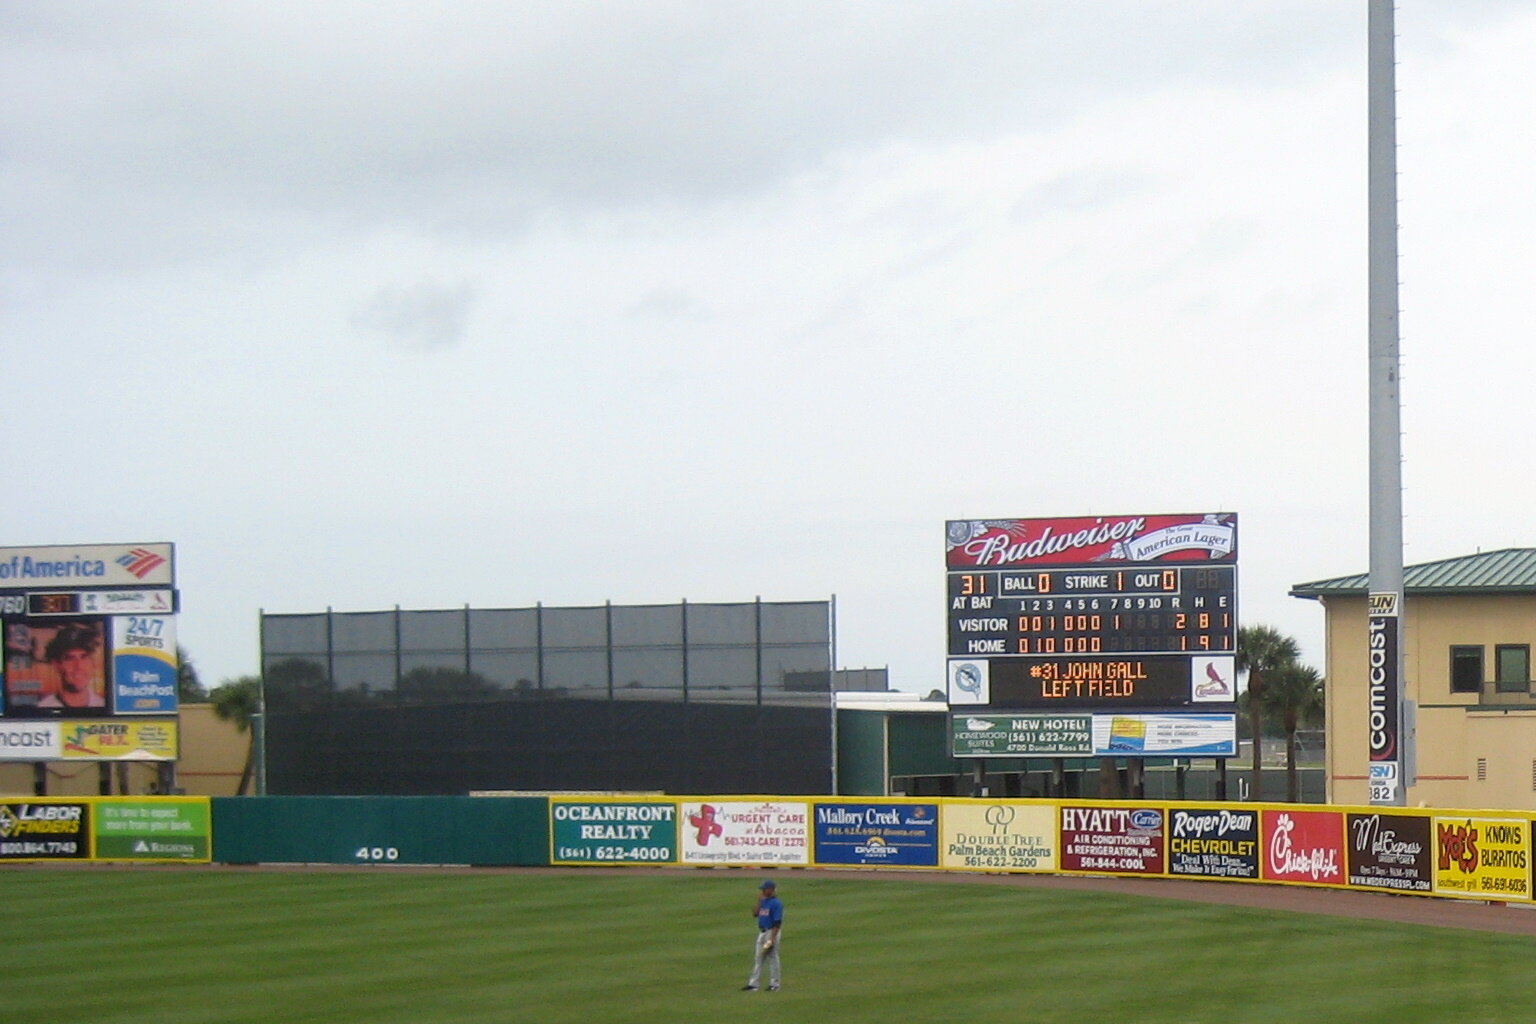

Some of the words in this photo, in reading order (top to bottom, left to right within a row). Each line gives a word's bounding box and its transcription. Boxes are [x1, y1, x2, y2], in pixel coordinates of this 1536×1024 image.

[965, 518, 1145, 565] Budweiser
[1136, 529, 1190, 558] American
[1194, 527, 1228, 547] Lager
[22, 554, 105, 578] America
[961, 575, 985, 594] 31
[1004, 577, 1035, 592] BALL
[1038, 573, 1050, 593] 0
[1065, 575, 1108, 590] STRIKE
[1135, 574, 1159, 588] OUT
[1163, 570, 1175, 590] 0
[953, 597, 966, 609] AT
[971, 597, 992, 609] BAT
[128, 616, 164, 637] 24/7
[959, 618, 1008, 632] VISITOR
[1020, 616, 1028, 632] 0
[1033, 616, 1042, 631] 0
[1064, 616, 1073, 631] 0
[1077, 616, 1086, 631] 0
[1091, 616, 1100, 630] 0
[1176, 613, 1185, 628] 2
[1200, 613, 1208, 628] 8
[125, 634, 164, 649] SPORTS
[968, 640, 1006, 652] HOME
[1019, 637, 1028, 653] 0
[1046, 637, 1054, 652] 0
[1064, 637, 1073, 652] 0
[1077, 637, 1086, 652] 0
[1091, 636, 1100, 652] 0
[1200, 636, 1208, 651] 9
[1030, 663, 1059, 680] #31
[1062, 662, 1102, 680] JOHN
[1106, 662, 1147, 680] GALL
[1042, 680, 1083, 698] LEFT
[1088, 679, 1133, 697] FIELD
[1370, 619, 1386, 750] comcast
[88, 724, 128, 735] GATER
[1011, 719, 1040, 731] NEW
[1043, 718, 1087, 731] HOTEL!
[955, 731, 1008, 741] HOMEWOOD
[1008, 731, 1036, 744] (561)
[1038, 731, 1090, 743] 622-7799
[967, 739, 995, 749] SUITES
[19, 805, 82, 821] LABOR
[554, 806, 675, 822] OCEANFRONT
[731, 814, 771, 824] URGENT
[777, 814, 805, 824] CARE
[819, 807, 864, 827] Mallory
[866, 807, 900, 825] Creek
[1062, 808, 1130, 833] HYATT
[1134, 813, 1162, 827] Carrier
[14, 821, 81, 836] FINDERS
[754, 824, 805, 836] Abacoa
[1173, 811, 1218, 838] Roger
[1217, 810, 1252, 837] Dean
[581, 825, 653, 839] REALTY
[1012, 833, 1042, 846] TREE
[1352, 814, 1423, 859] MedExpress
[1485, 825, 1521, 845] KNOWS
[1073, 834, 1091, 844] AIR
[1092, 835, 1150, 846] CONDITIONING
[1171, 837, 1255, 856] CHEVROLET
[356, 847, 399, 860] 400
[559, 846, 591, 860] (561)
[595, 846, 670, 861] 622-4000
[948, 844, 974, 857] Palm
[975, 844, 1007, 857] Beach
[1008, 845, 1051, 858] Gardens
[1481, 848, 1526, 869] BURRITOS
[964, 856, 1037, 868] 561-622-2200
